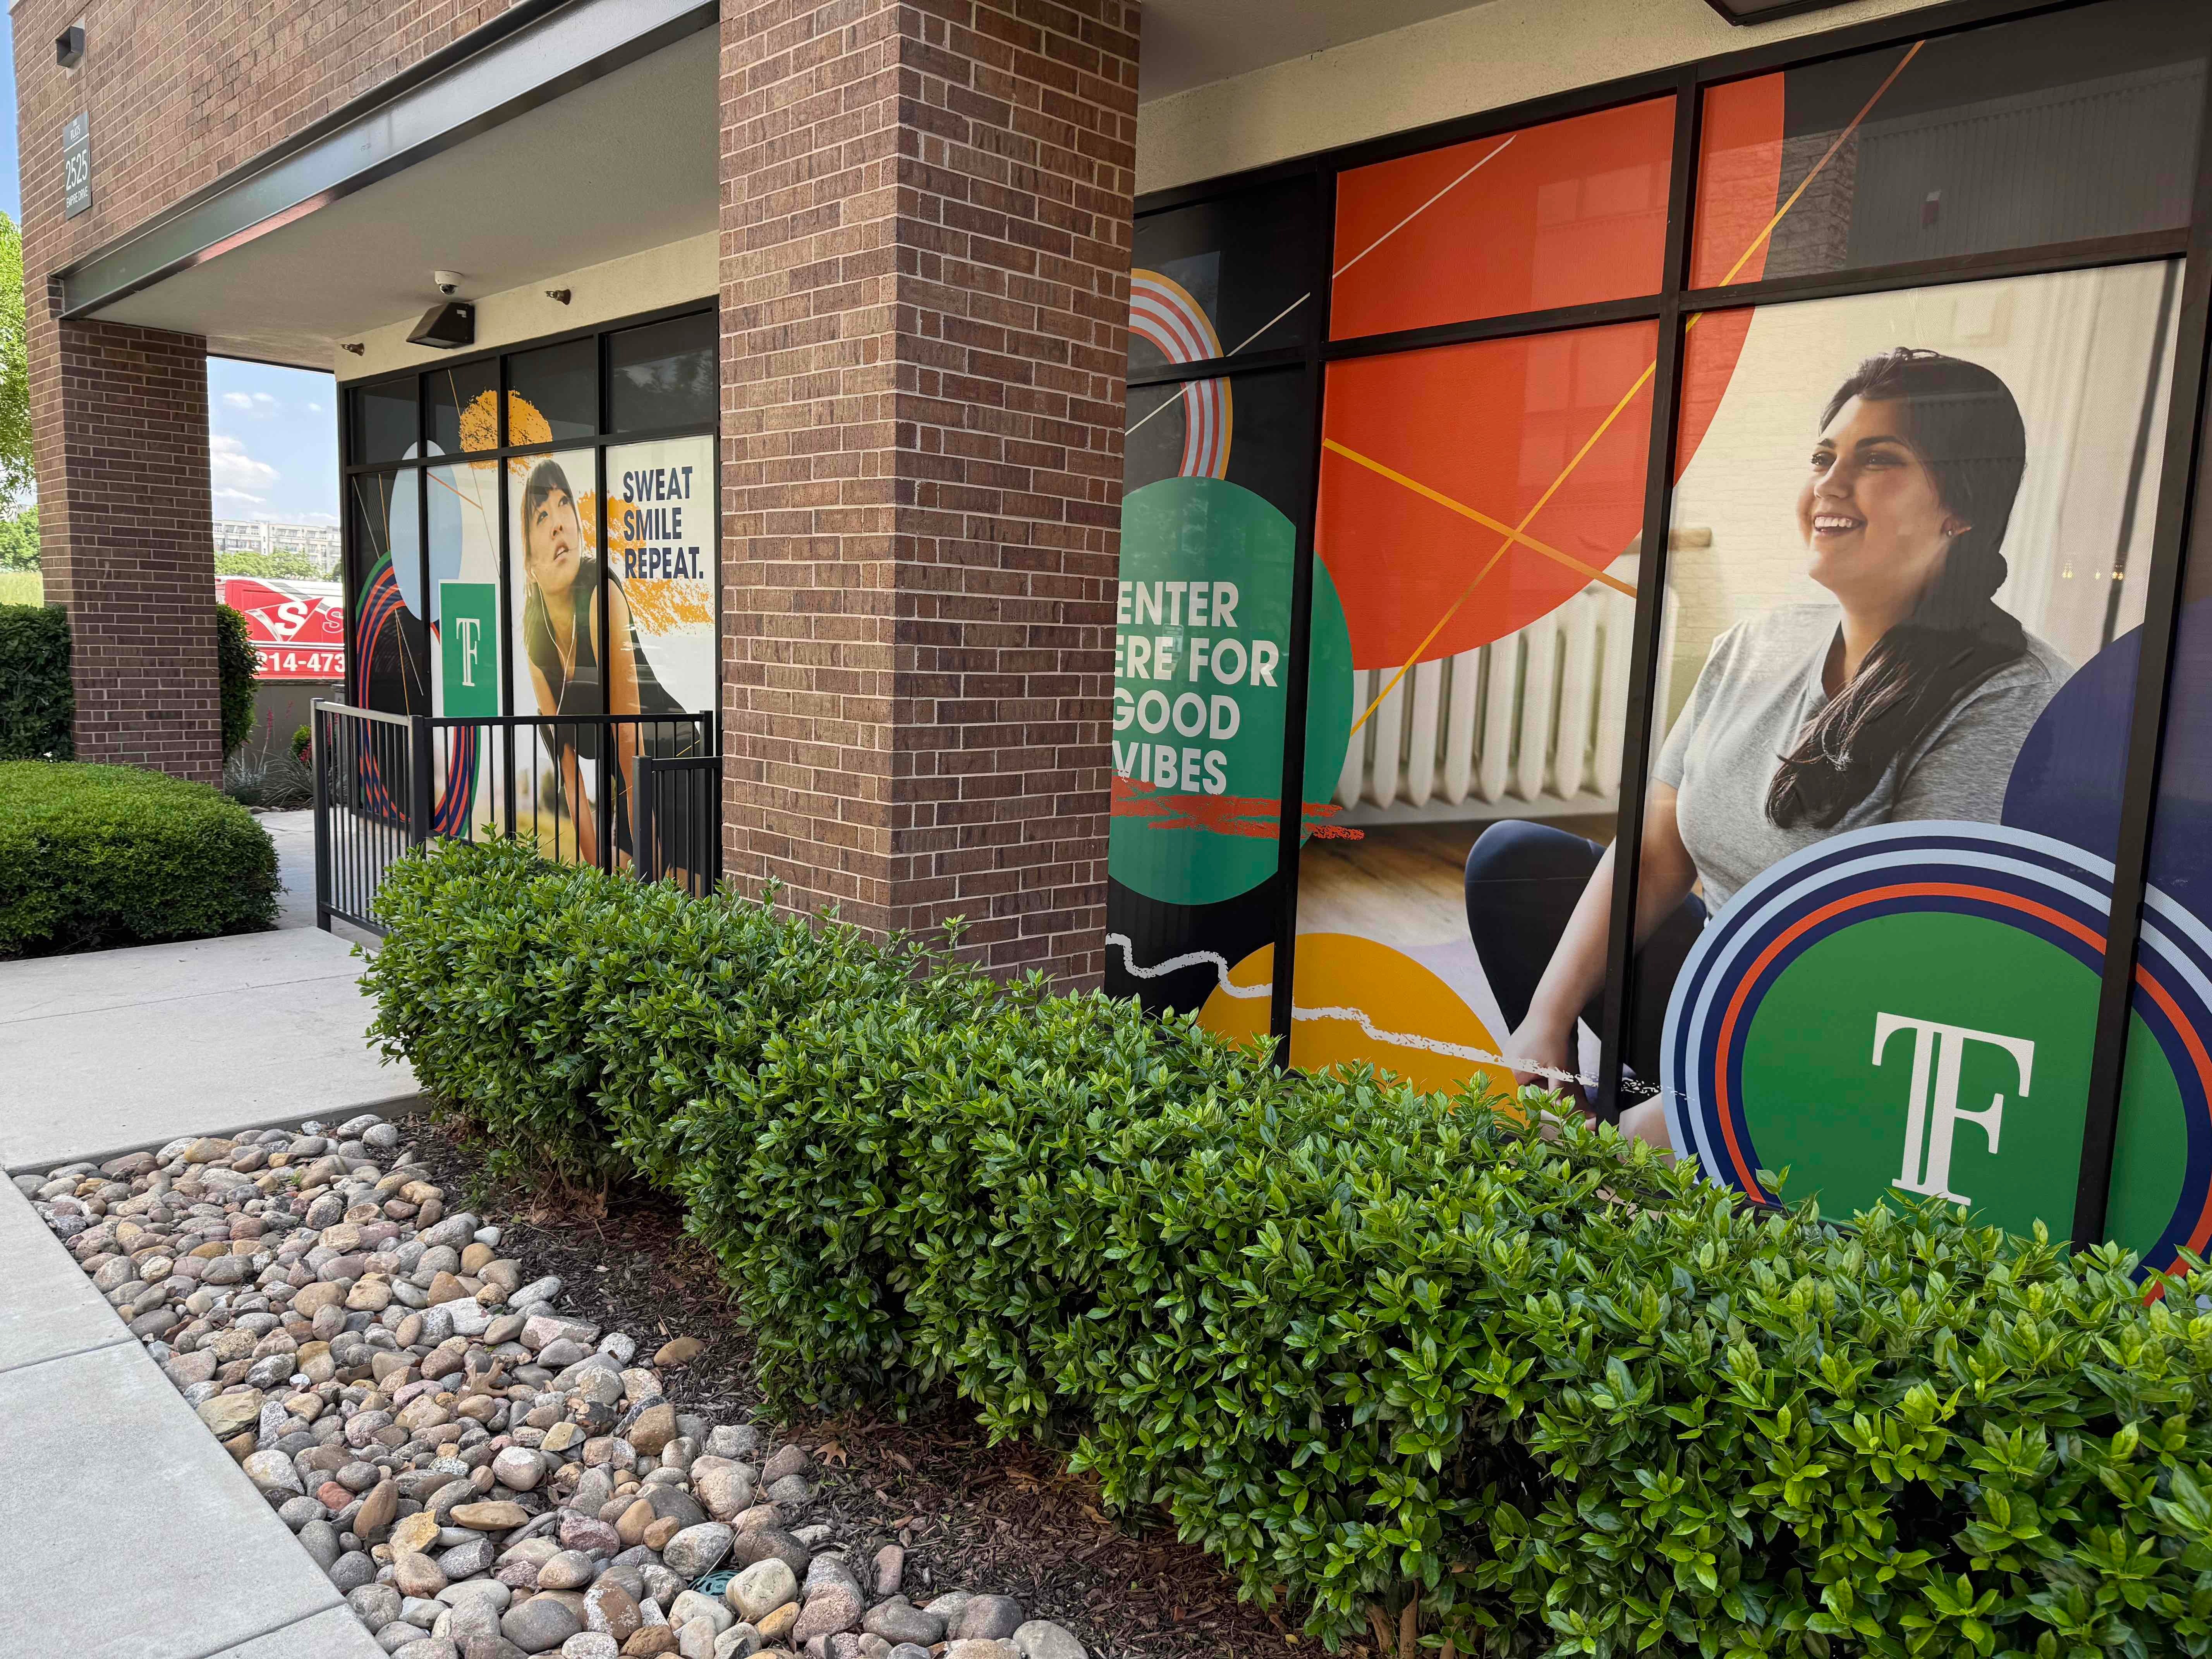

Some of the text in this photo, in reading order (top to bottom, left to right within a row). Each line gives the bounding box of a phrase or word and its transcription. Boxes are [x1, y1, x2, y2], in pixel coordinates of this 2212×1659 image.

[66, 149, 87, 191] 2525
[66, 186, 88, 208] EMPIRE DRIVE
[623, 466, 693, 503] SWEAT
[623, 507, 682, 541] SMILE
[625, 547, 704, 579] REPEAT.
[1117, 581, 1239, 627] ENTER
[456, 618, 480, 687] TF
[1189, 638, 1279, 687] FOR
[1113, 687, 1240, 740] GOOD
[1112, 740, 1227, 795] VIBES
[1872, 1012, 2035, 1206] TF
